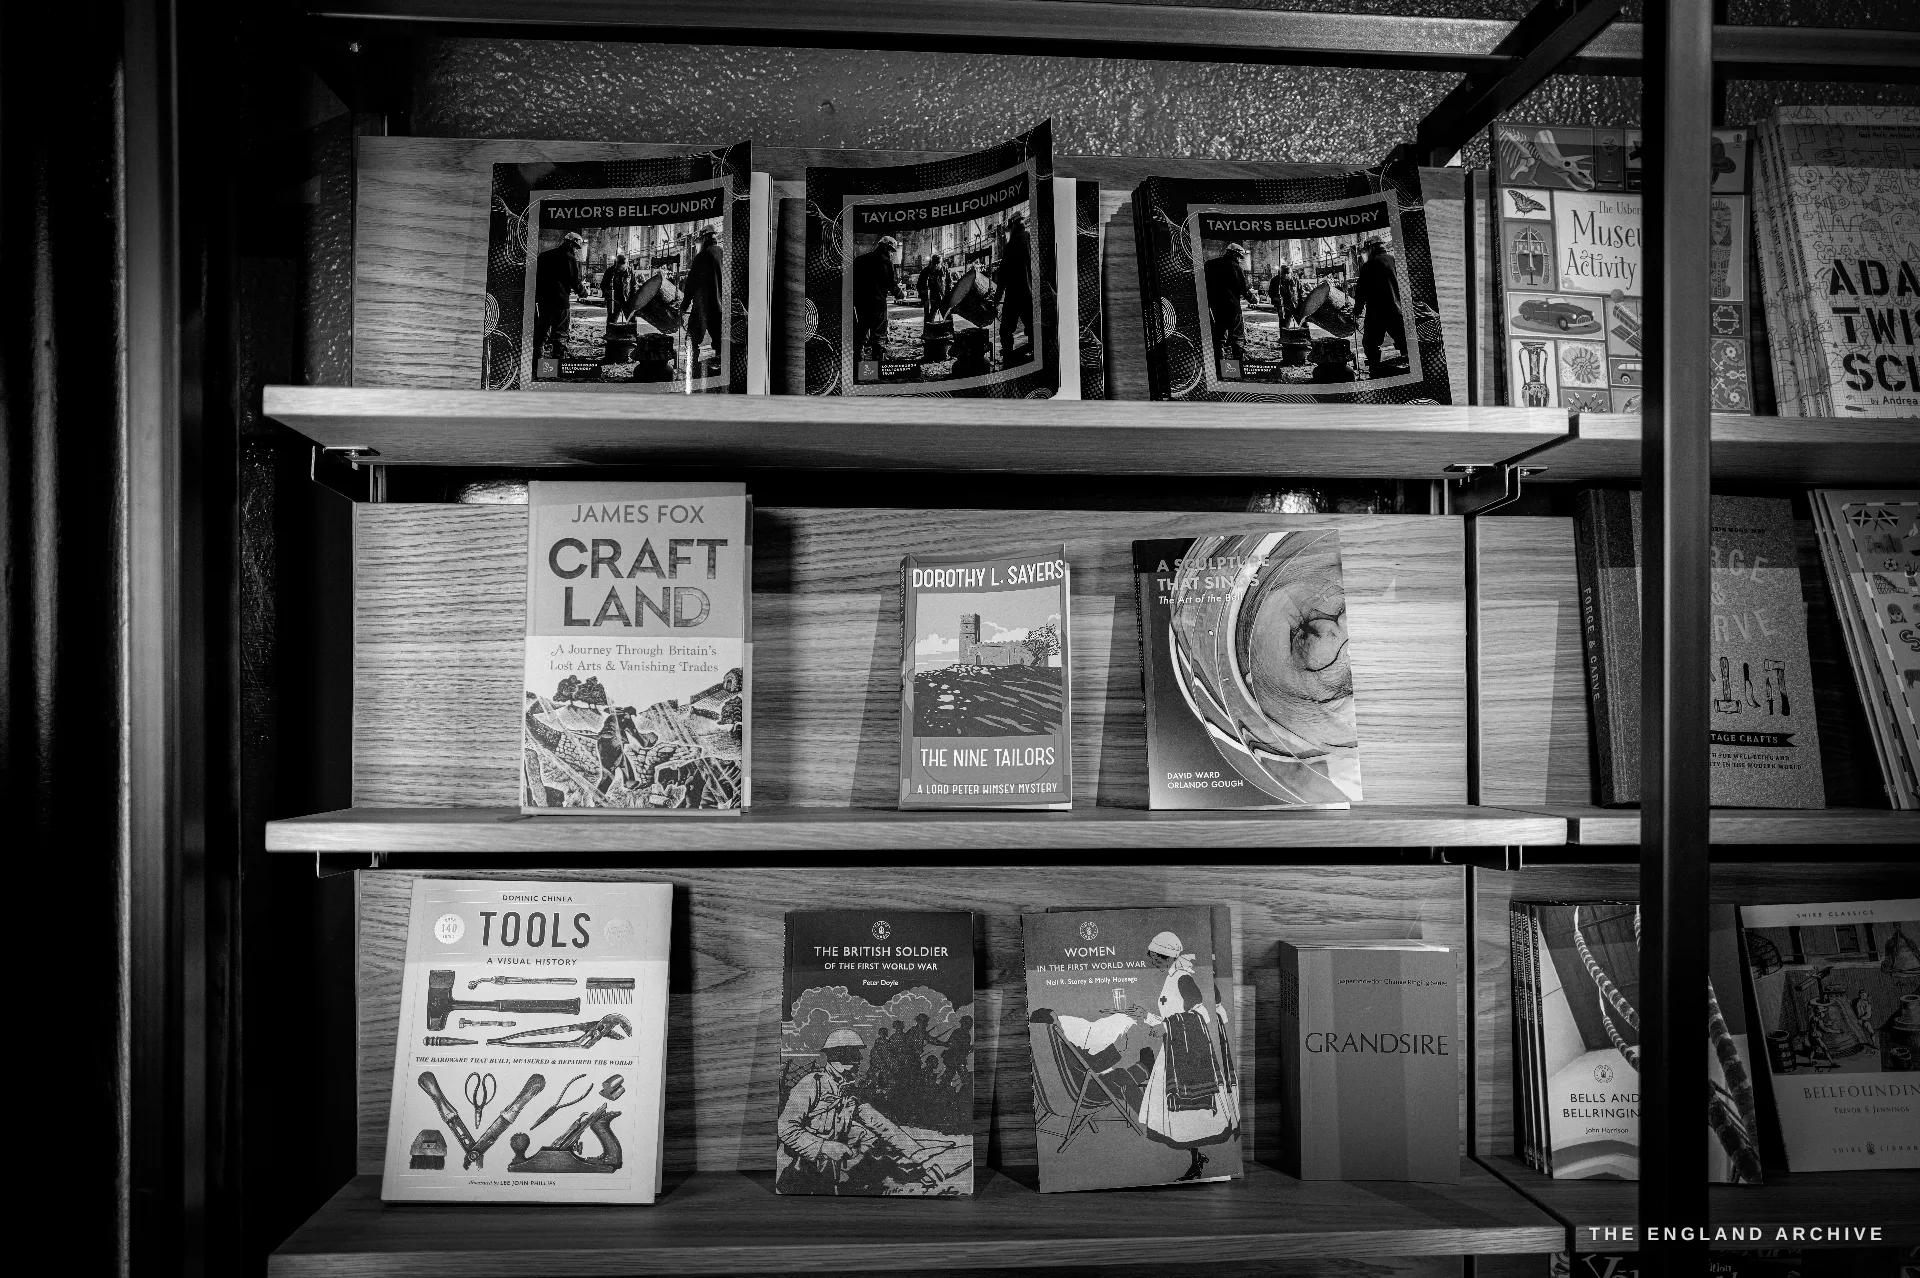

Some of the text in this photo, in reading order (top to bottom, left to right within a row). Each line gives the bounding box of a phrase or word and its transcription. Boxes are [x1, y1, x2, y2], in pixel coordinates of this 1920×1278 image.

[547, 195, 717, 220] TAYLOR'S BELLFOUNDRY
[861, 181, 1024, 224] TAYLOR'S BELLFOUNDRY
[1596, 200, 1613, 214] The
[1206, 209, 1380, 233] TAYLOR'S BELLFOUNDRY
[1564, 247, 1637, 290] Activity
[1829, 259, 1920, 297] ADA
[1883, 396, 1918, 405] Andrea
[571, 504, 705, 524] JAMES FOX
[548, 537, 729, 580] CRAFT
[1156, 554, 1270, 573] A SCULPTURE
[912, 559, 1065, 588] DOROTHY L. SAYERS
[1157, 573, 1260, 592] THAT SINGS
[1159, 595, 1175, 605] The
[1178, 595, 1194, 604] Art
[1196, 593, 1206, 603] of
[1207, 593, 1222, 603] the
[563, 585, 711, 628] LAND
[1583, 587, 1595, 635] FORGE
[1589, 640, 1596, 650] &
[551, 645, 717, 657] A Journey Through Britain's
[549, 661, 719, 674] Lost Arts & Vanishing Trades
[1739, 734, 1778, 744] CRAFTS
[920, 747, 1055, 767] THE NINE TAILORS
[1167, 771, 1220, 780] DAVID WARD
[917, 782, 1058, 795] A LORD PETER WIMSEY MYSTERY
[1167, 780, 1244, 789] ORLANDO GOUGH
[502, 894, 573, 903] DOMINIC CHINEA
[1828, 909, 1875, 918] CLASSICS
[441, 923, 458, 933] 140
[479, 911, 591, 948] TOOLS
[814, 946, 949, 958] THE BRITISH SOLDIER
[1064, 946, 1116, 958] WOMEN
[487, 957, 577, 966] A VISUAL HISTORY
[882, 963, 916, 971] WORLD
[1047, 964, 1064, 972] THE
[1066, 963, 1090, 971] FIRST
[1092, 962, 1124, 970] WORLD
[862, 979, 899, 988] Peter Doyle
[1046, 978, 1059, 986] Neil
[1068, 978, 1088, 987] Storey
[1304, 1032, 1449, 1056] GRANDSIRE
[415, 1056, 429, 1064] THE
[430, 1056, 468, 1064] HARDWARE
[1570, 1093, 1639, 1103] BELLS AND
[1864, 1106, 1870, 1114] S
[1585, 1127, 1600, 1135] John
